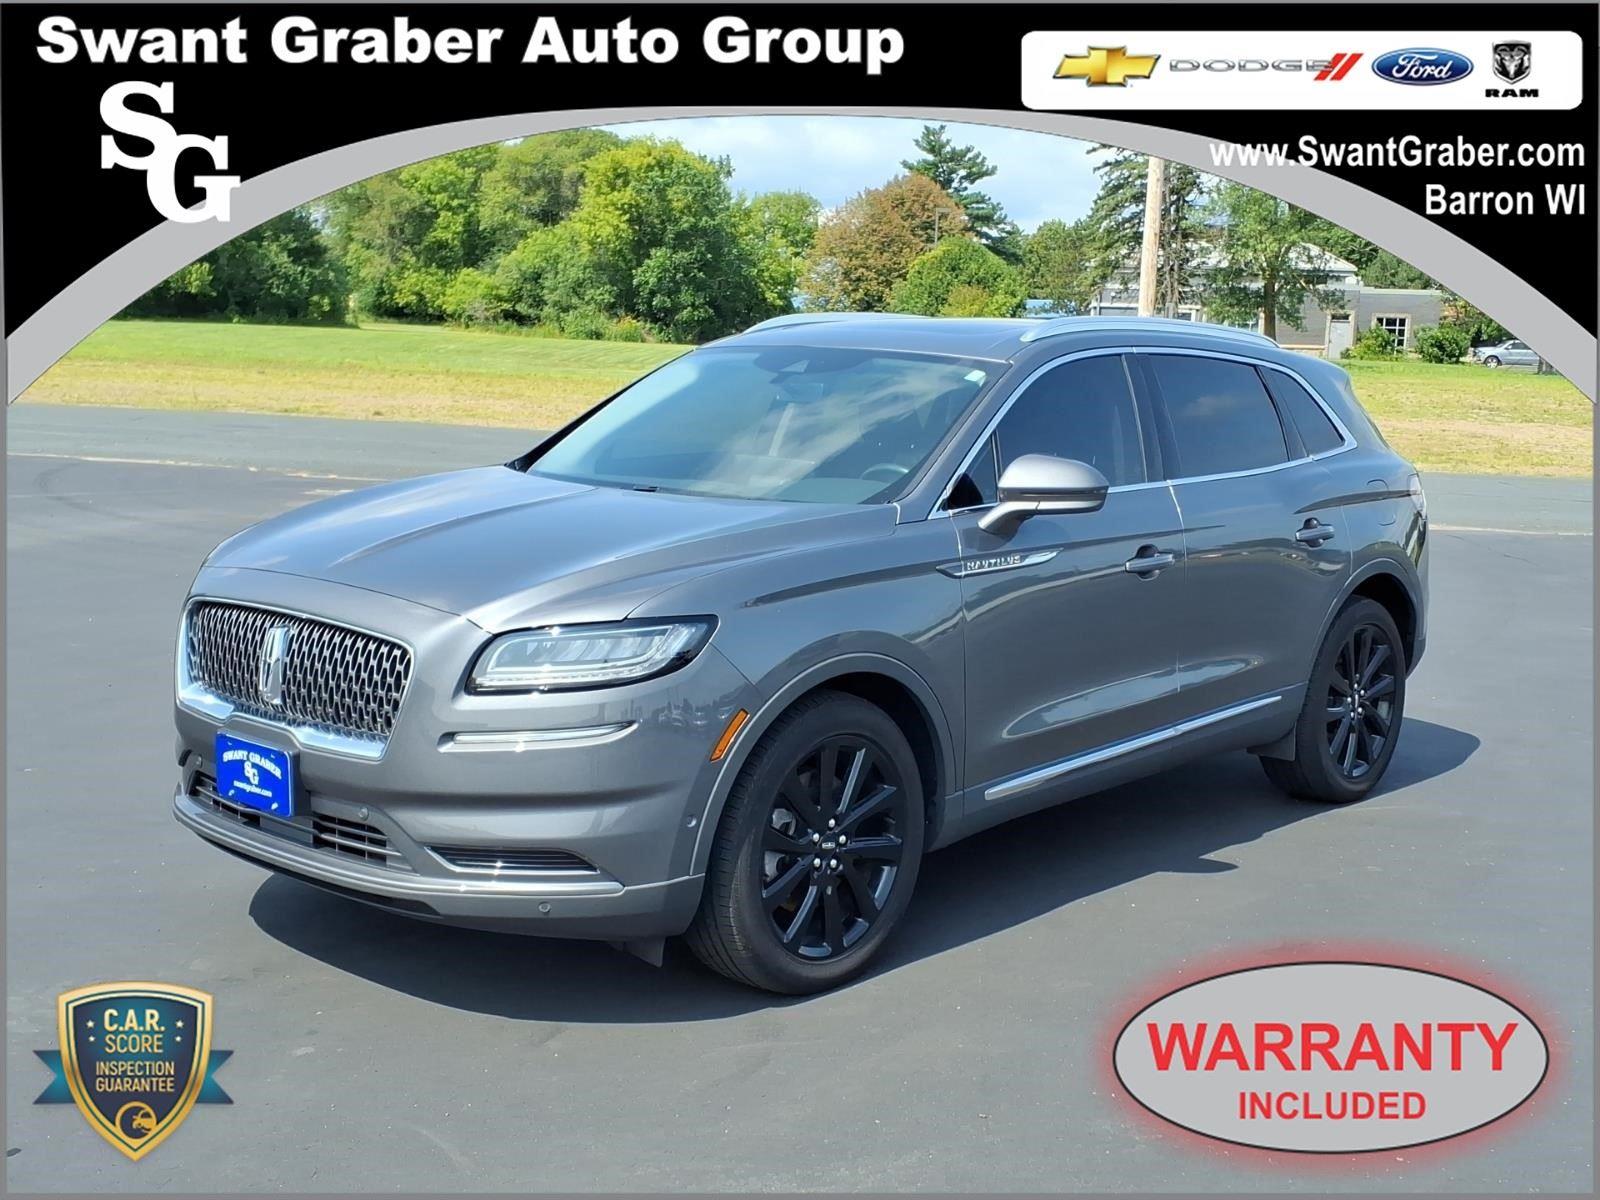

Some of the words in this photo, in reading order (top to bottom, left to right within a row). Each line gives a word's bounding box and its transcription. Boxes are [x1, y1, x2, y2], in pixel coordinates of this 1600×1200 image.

[966, 555, 1022, 571] NAUTILUS
[222, 750, 248, 762] SWANT
[249, 752, 281, 780] GRABER
